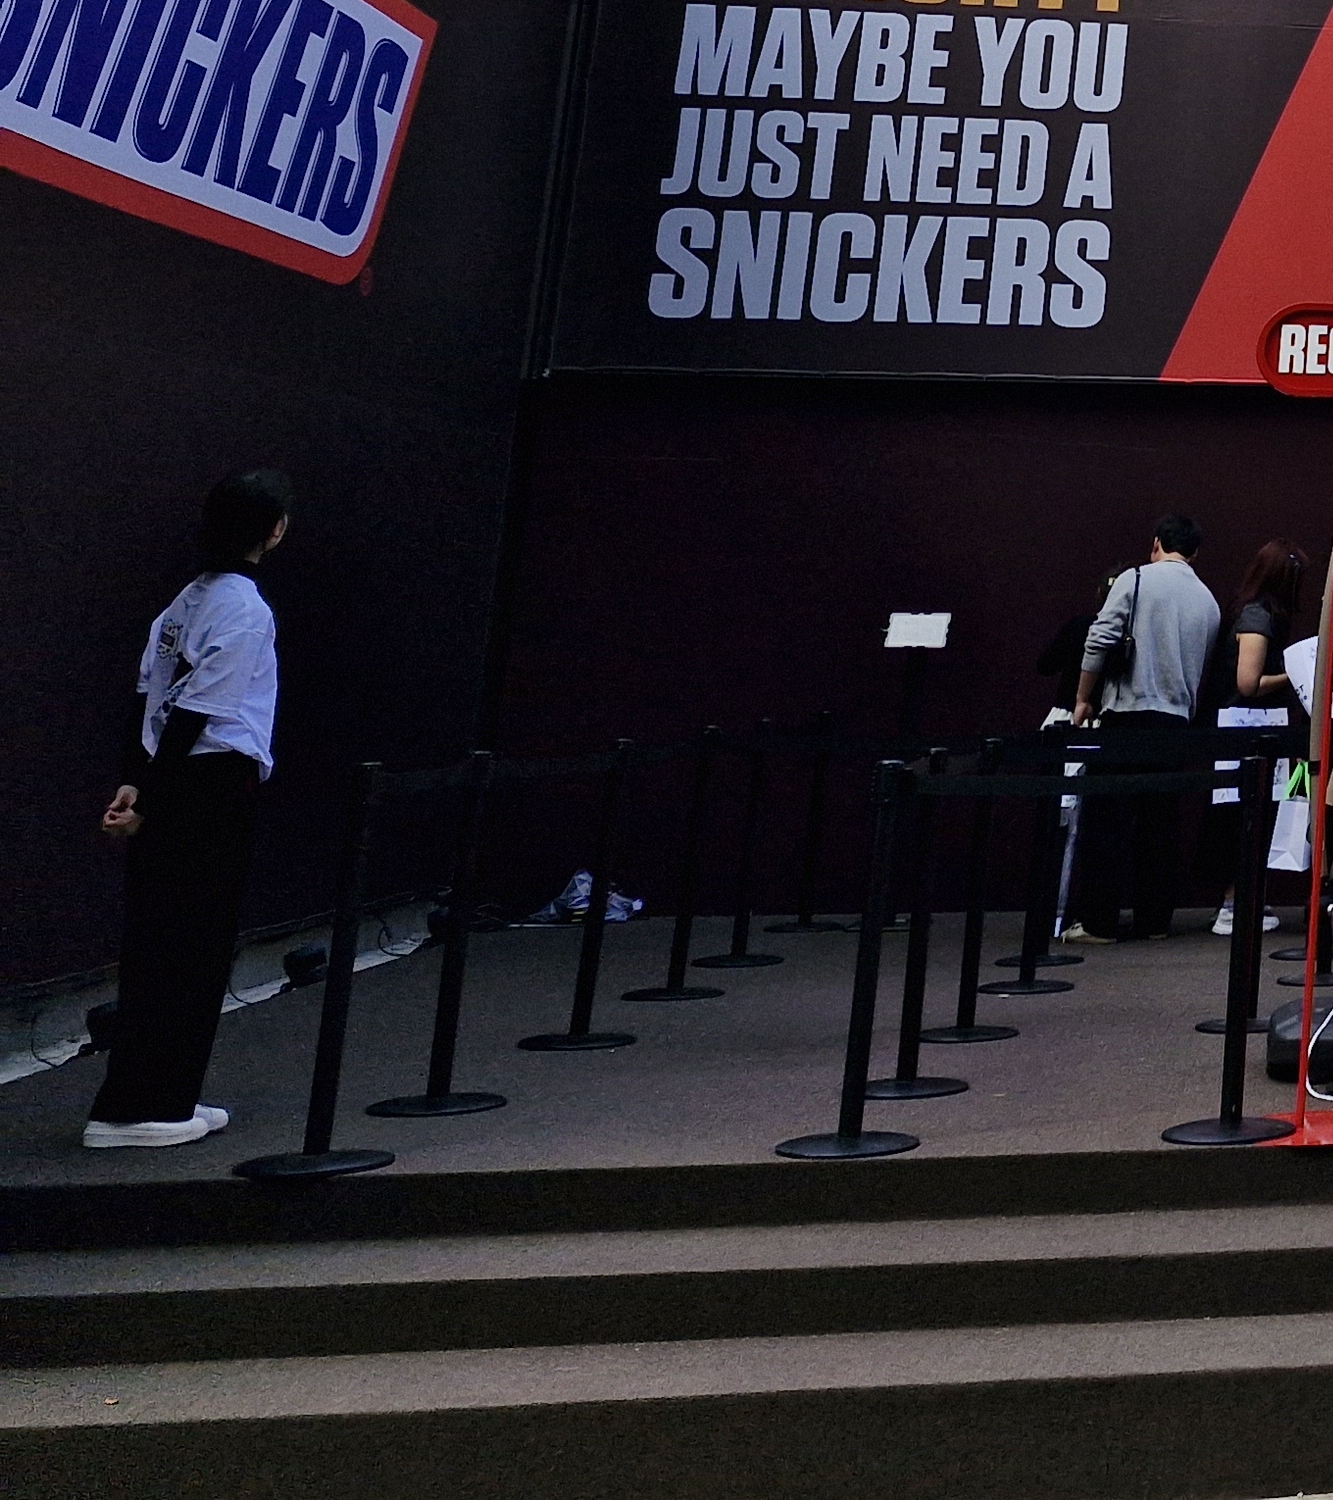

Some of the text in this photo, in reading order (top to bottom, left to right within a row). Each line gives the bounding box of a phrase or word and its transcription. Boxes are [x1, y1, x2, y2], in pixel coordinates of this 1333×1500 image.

[674, 3, 1129, 113] MAYBE YOU
[660, 108, 1113, 210] JUST NEED A
[648, 207, 1111, 328] SNICKERS
